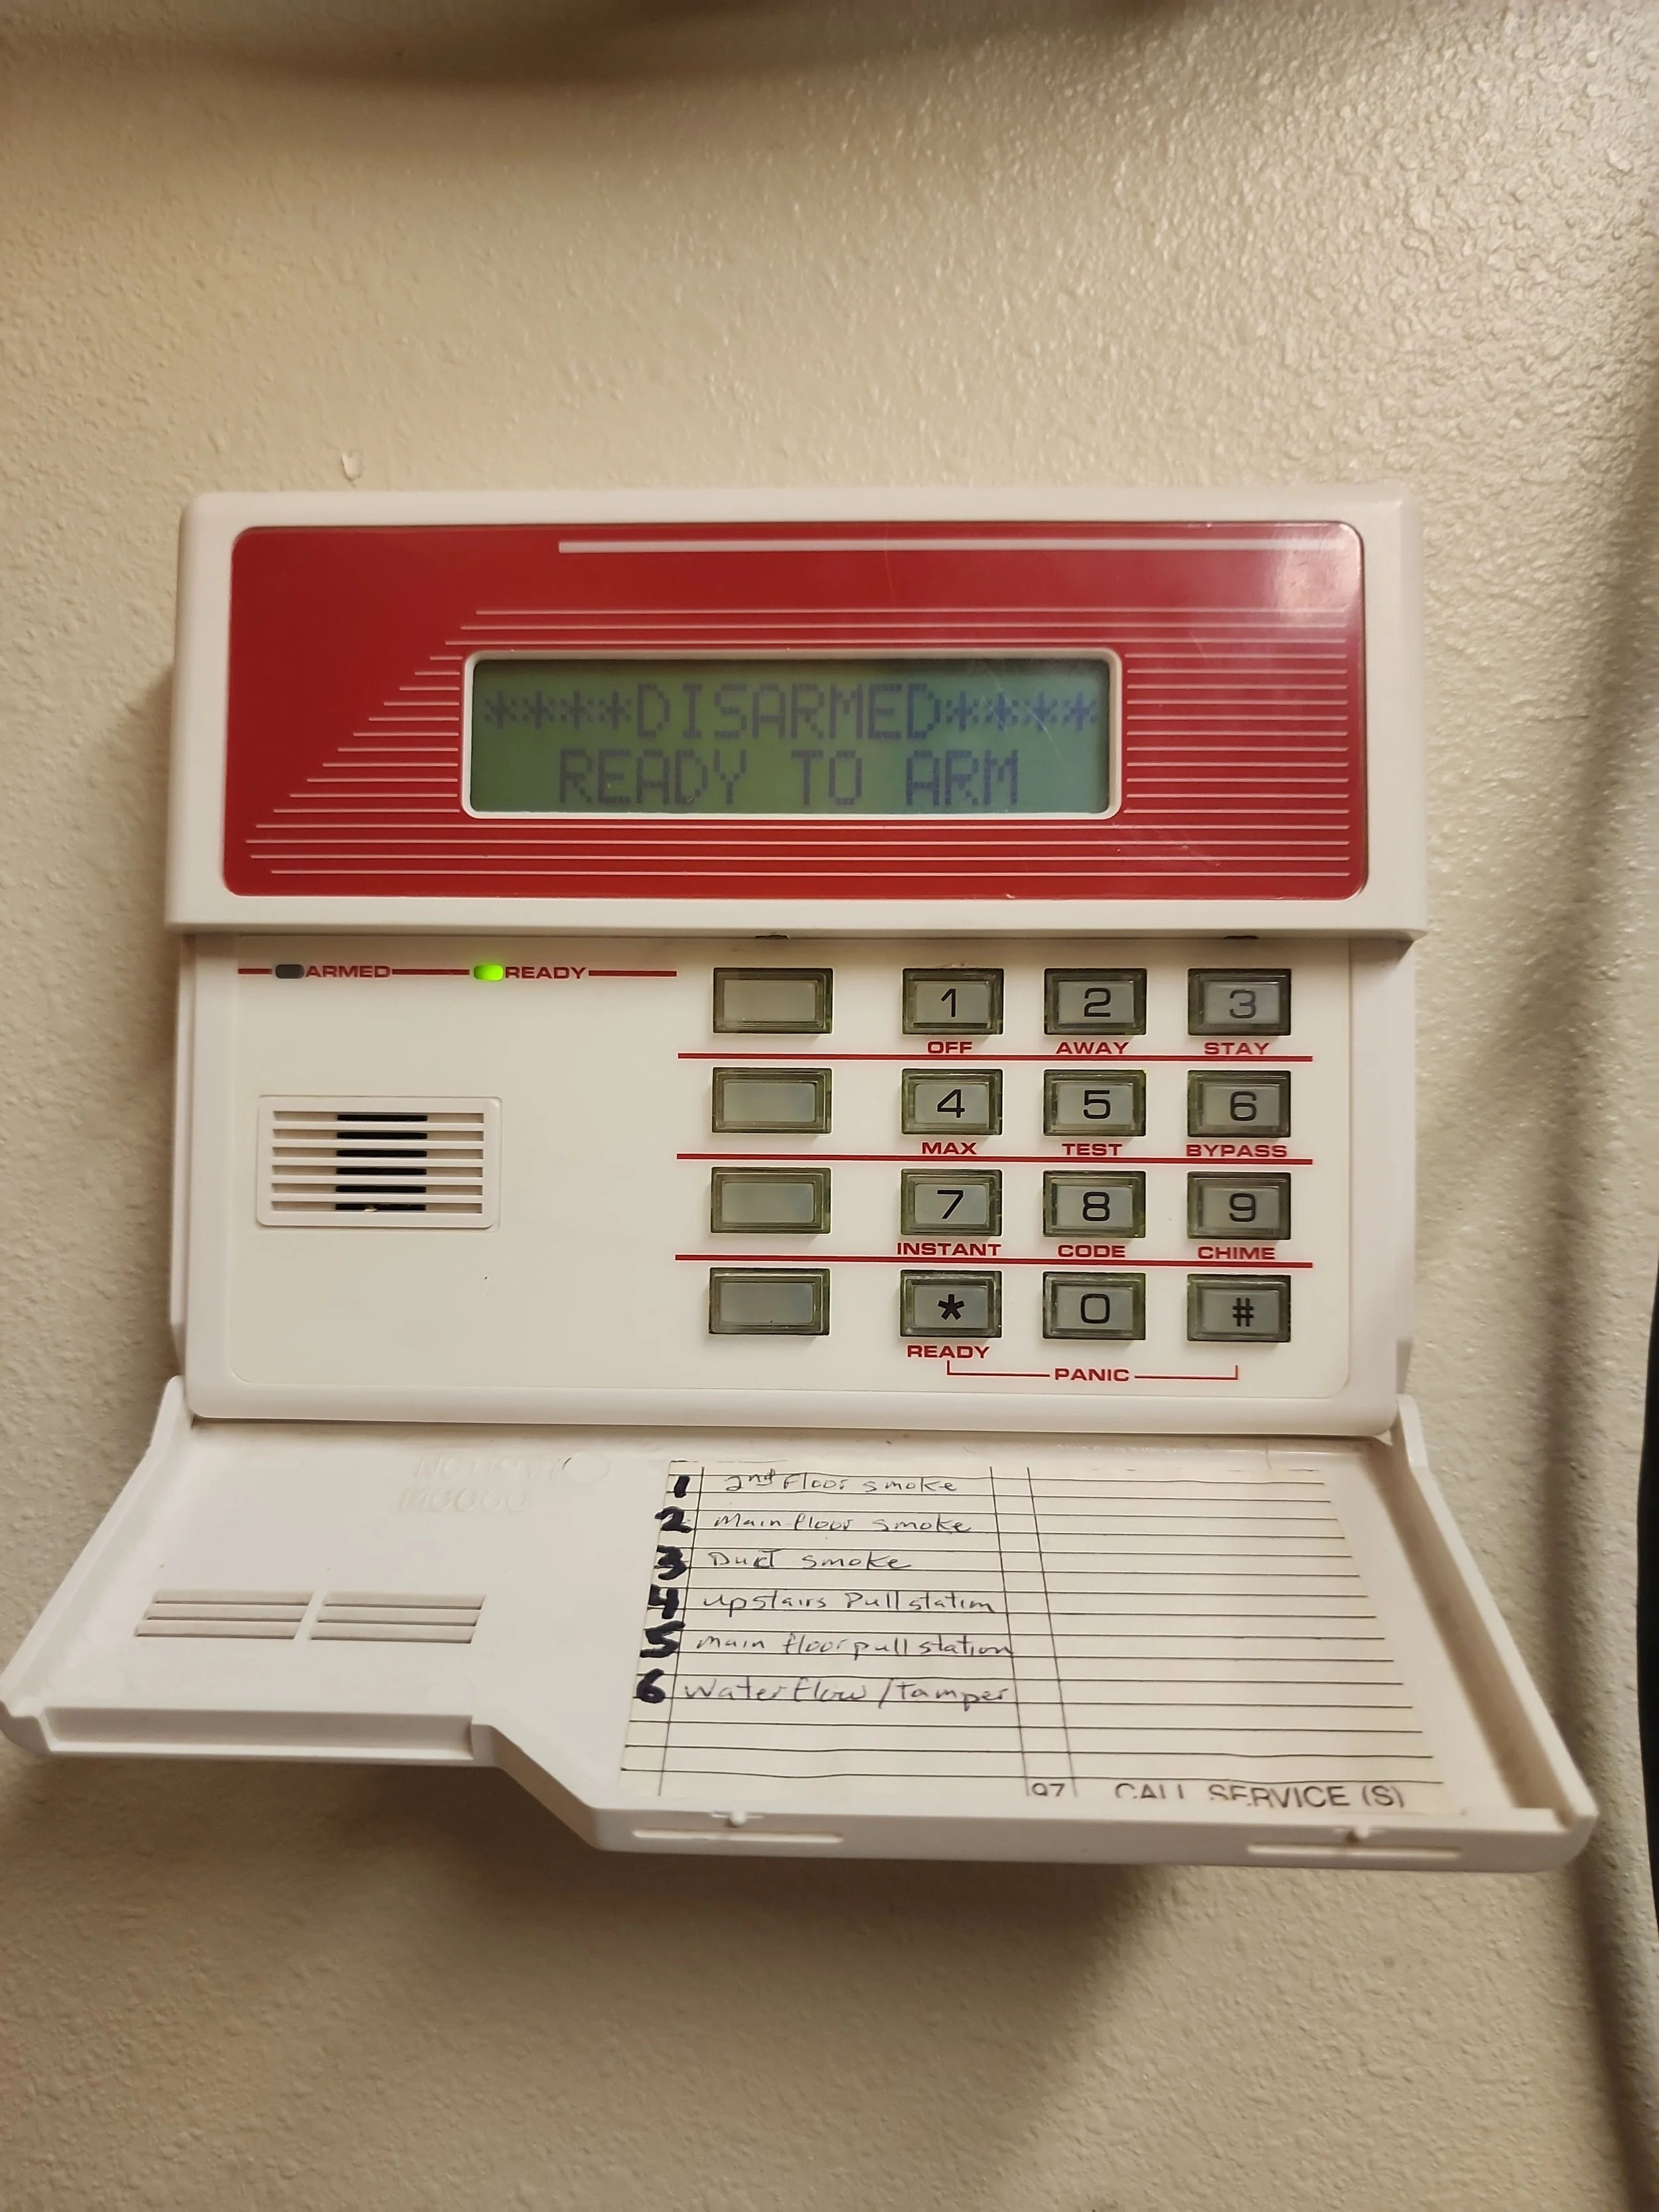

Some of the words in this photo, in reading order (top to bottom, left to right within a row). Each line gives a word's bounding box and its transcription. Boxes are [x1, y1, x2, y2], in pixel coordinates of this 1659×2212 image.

[559, 749, 747, 806] READY
[790, 749, 863, 806] TO
[906, 749, 1019, 807] ARM
[305, 965, 392, 979] ARMED
[504, 966, 587, 980] READY
[940, 988, 957, 1017] 1
[1084, 988, 1112, 1017] 2
[1228, 990, 1257, 1019] 3
[926, 1041, 973, 1054] OFF
[1055, 1042, 1130, 1055] AWAY
[1204, 1042, 1270, 1055] STAY
[936, 1089, 966, 1119] 4
[1082, 1090, 1112, 1120] 5
[1230, 1091, 1258, 1122] 6
[921, 1142, 977, 1155] MAX
[1062, 1143, 1123, 1157] TEST
[1186, 1144, 1288, 1158] BYPASS
[936, 1189, 964, 1220] 7
[1082, 1191, 1111, 1222] 8
[1228, 1193, 1256, 1222] 9
[897, 1243, 1002, 1257] INSTANT
[1058, 1244, 1126, 1258] CODE
[1198, 1246, 1275, 1260] CHIME
[1232, 1297, 1254, 1327] #
[907, 1345, 991, 1359] READY
[1054, 1368, 1129, 1382] PANIC
[674, 1475, 690, 1498] 1
[724, 1468, 776, 1491] 2nd
[863, 1477, 957, 1493] smoke
[654, 1506, 694, 1533] 2
[871, 1514, 972, 1534] smoke
[656, 1544, 687, 1580] 3
[802, 1551, 912, 1570] smoke
[648, 1584, 680, 1619] 4
[639, 1620, 686, 1658] 5
[919, 1635, 1015, 1655] station
[636, 1668, 666, 1704] 6
[1362, 1785, 1405, 1808] (S)
